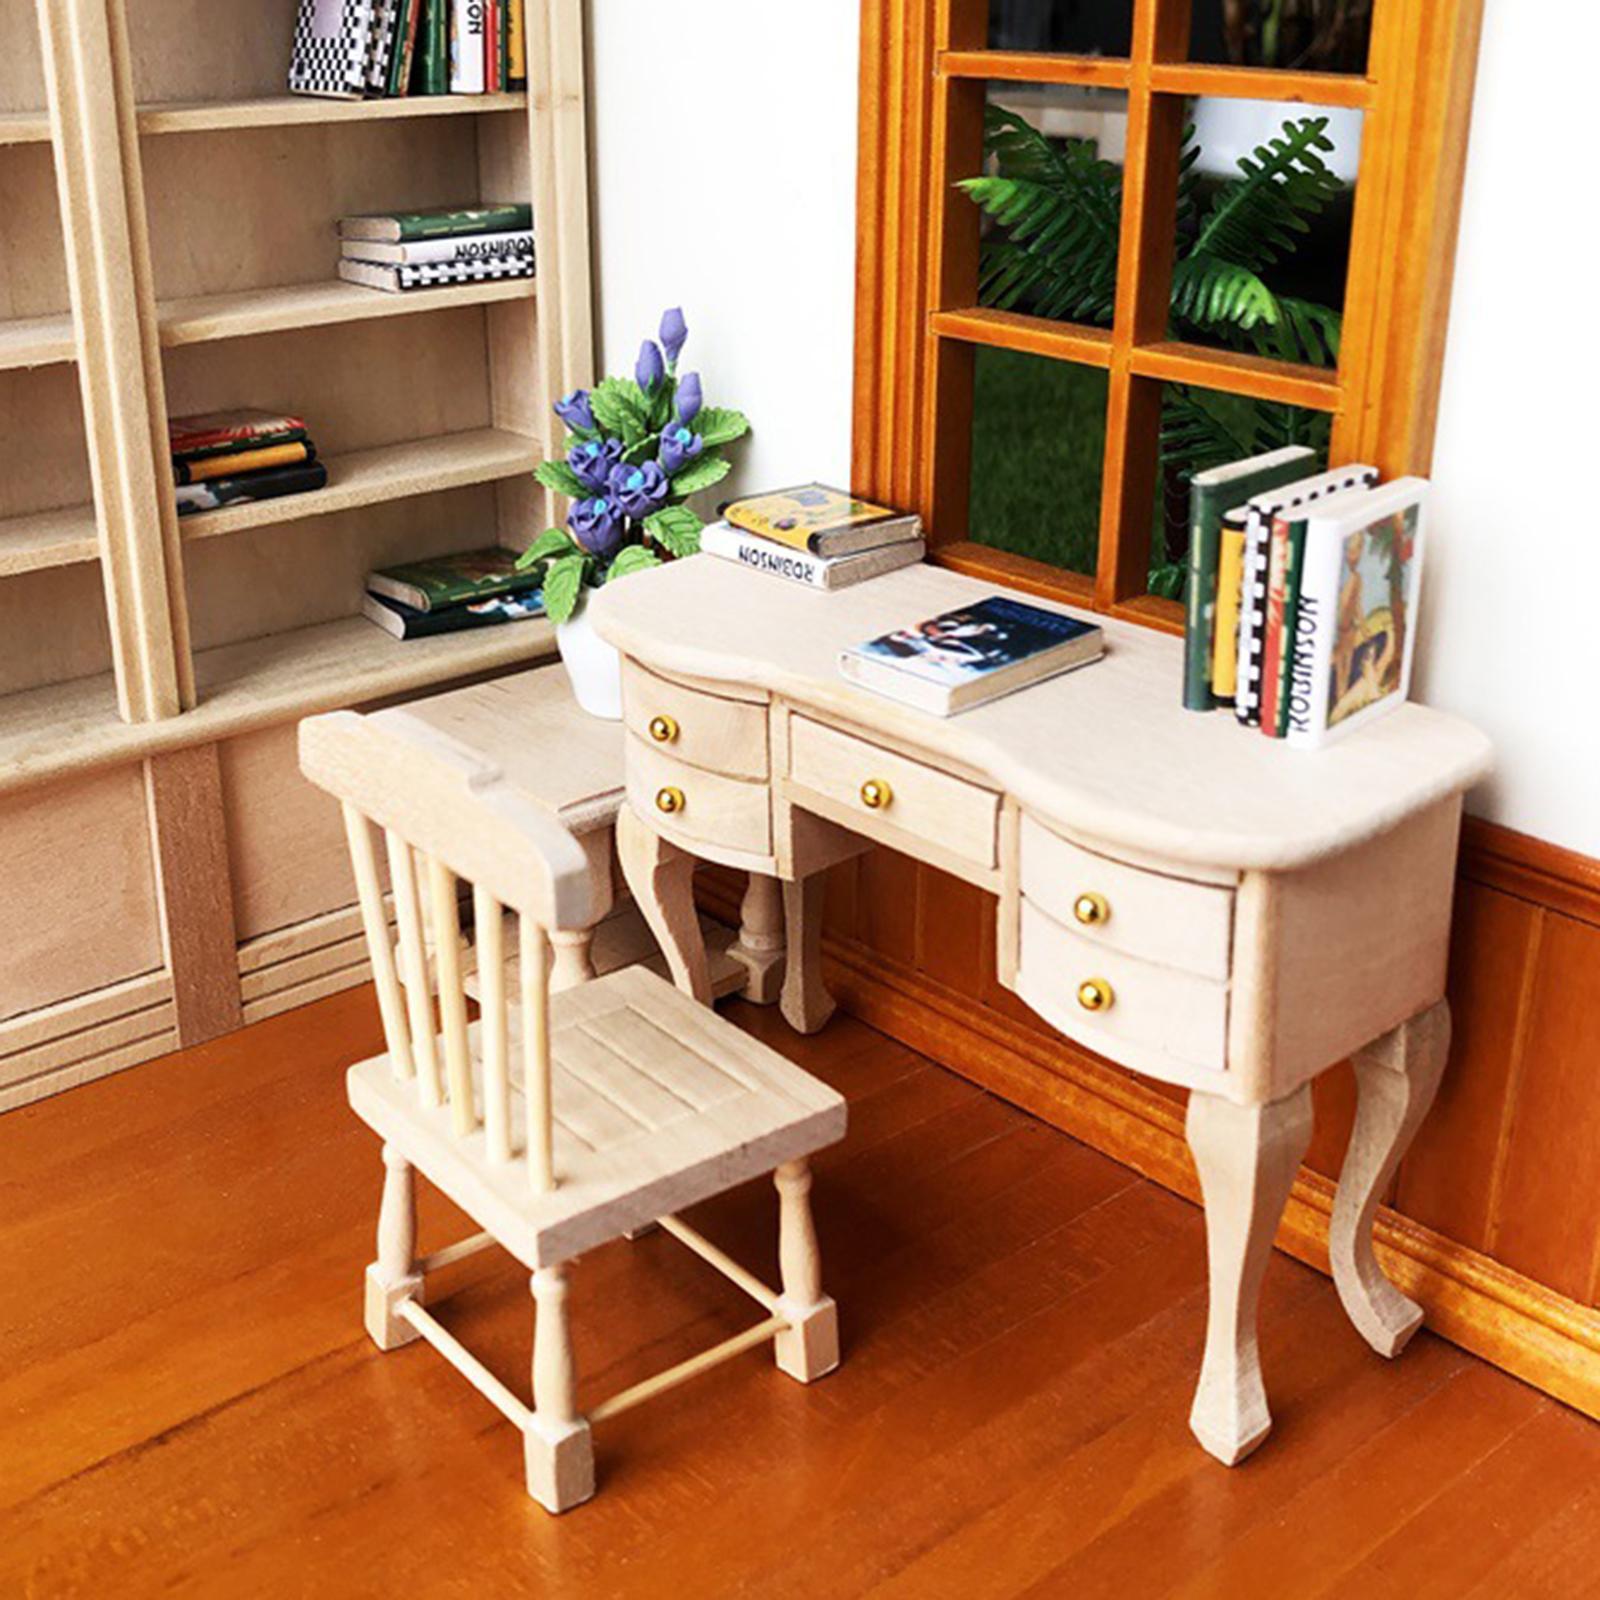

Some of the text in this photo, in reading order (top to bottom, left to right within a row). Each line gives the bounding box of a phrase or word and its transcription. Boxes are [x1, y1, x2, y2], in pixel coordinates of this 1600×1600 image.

[467, 0, 482, 35] ON
[738, 545, 815, 582] ROBINSON
[1288, 594, 1318, 732] ROBINSON
